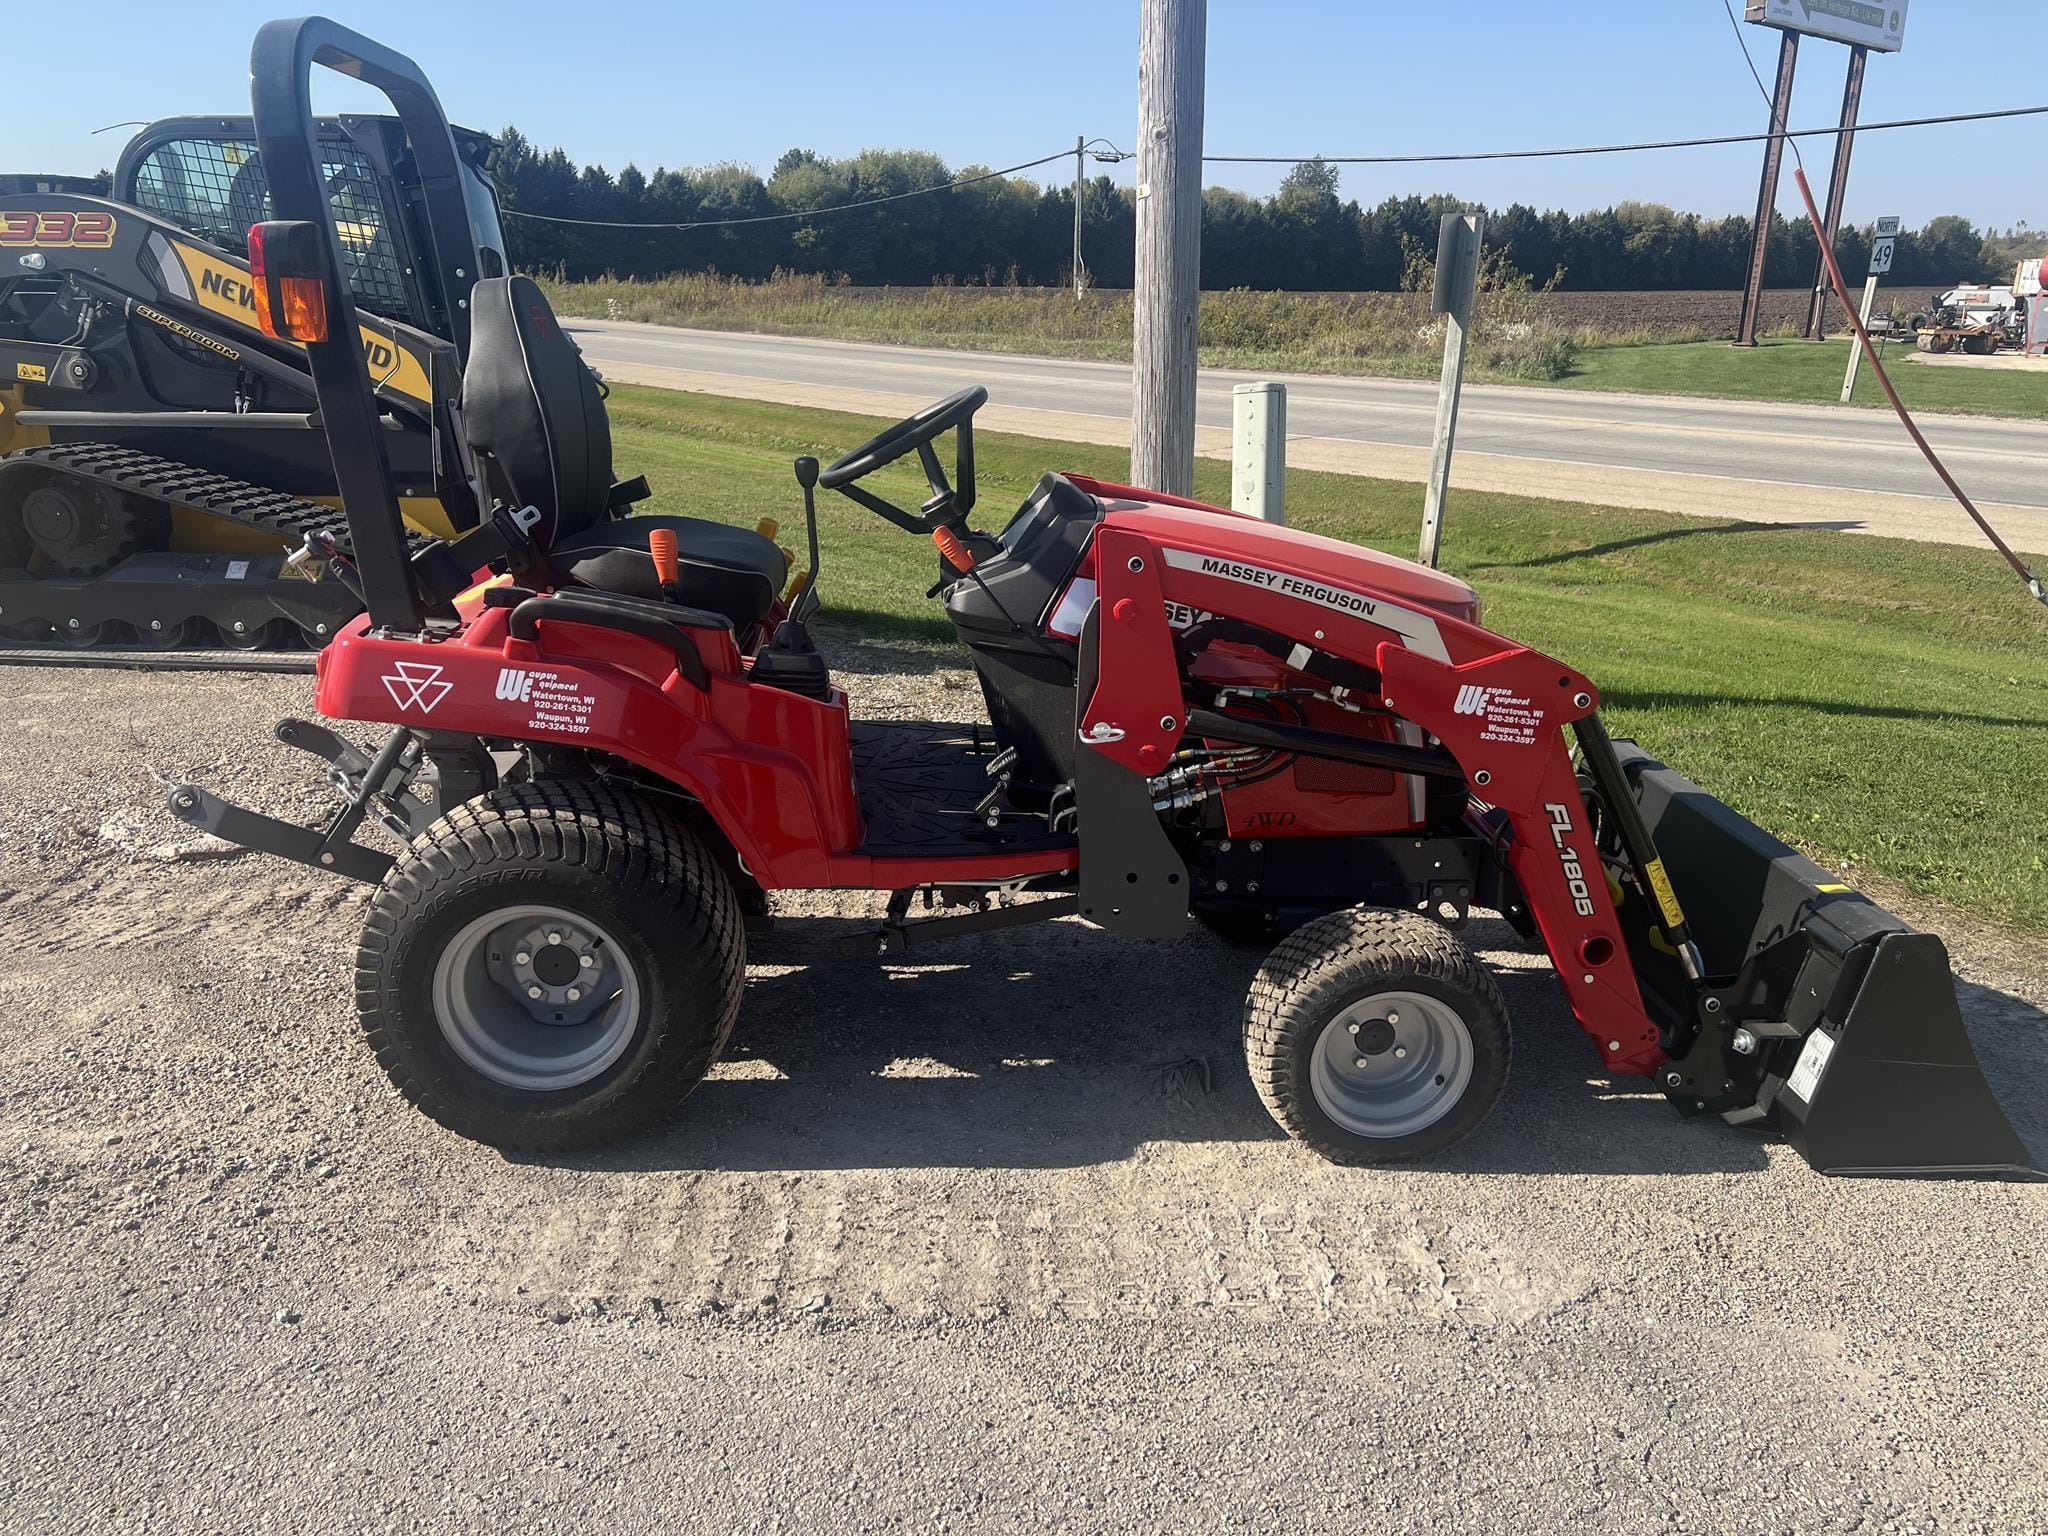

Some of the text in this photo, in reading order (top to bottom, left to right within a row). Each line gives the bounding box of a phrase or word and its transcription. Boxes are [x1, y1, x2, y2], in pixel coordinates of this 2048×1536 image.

[0, 211, 116, 248] 332
[1877, 220, 1897, 233] NORTH
[1873, 245, 1892, 266] 49
[201, 268, 257, 312] NEW
[1201, 558, 1376, 616] MASSEY FERGUSON
[532, 690, 595, 705] Watertown, WI
[534, 700, 592, 713] 920-261-5301
[1486, 705, 1544, 718] Watertown, WI
[536, 711, 586, 724] Waupun, WI
[1487, 713, 1540, 726] 920-261-5301
[528, 720, 590, 734] 920-324-3597
[1488, 724, 1534, 736] Waupun, WI
[1480, 732, 1536, 744] 920-324-3597
[1241, 811, 1297, 828] 4WD
